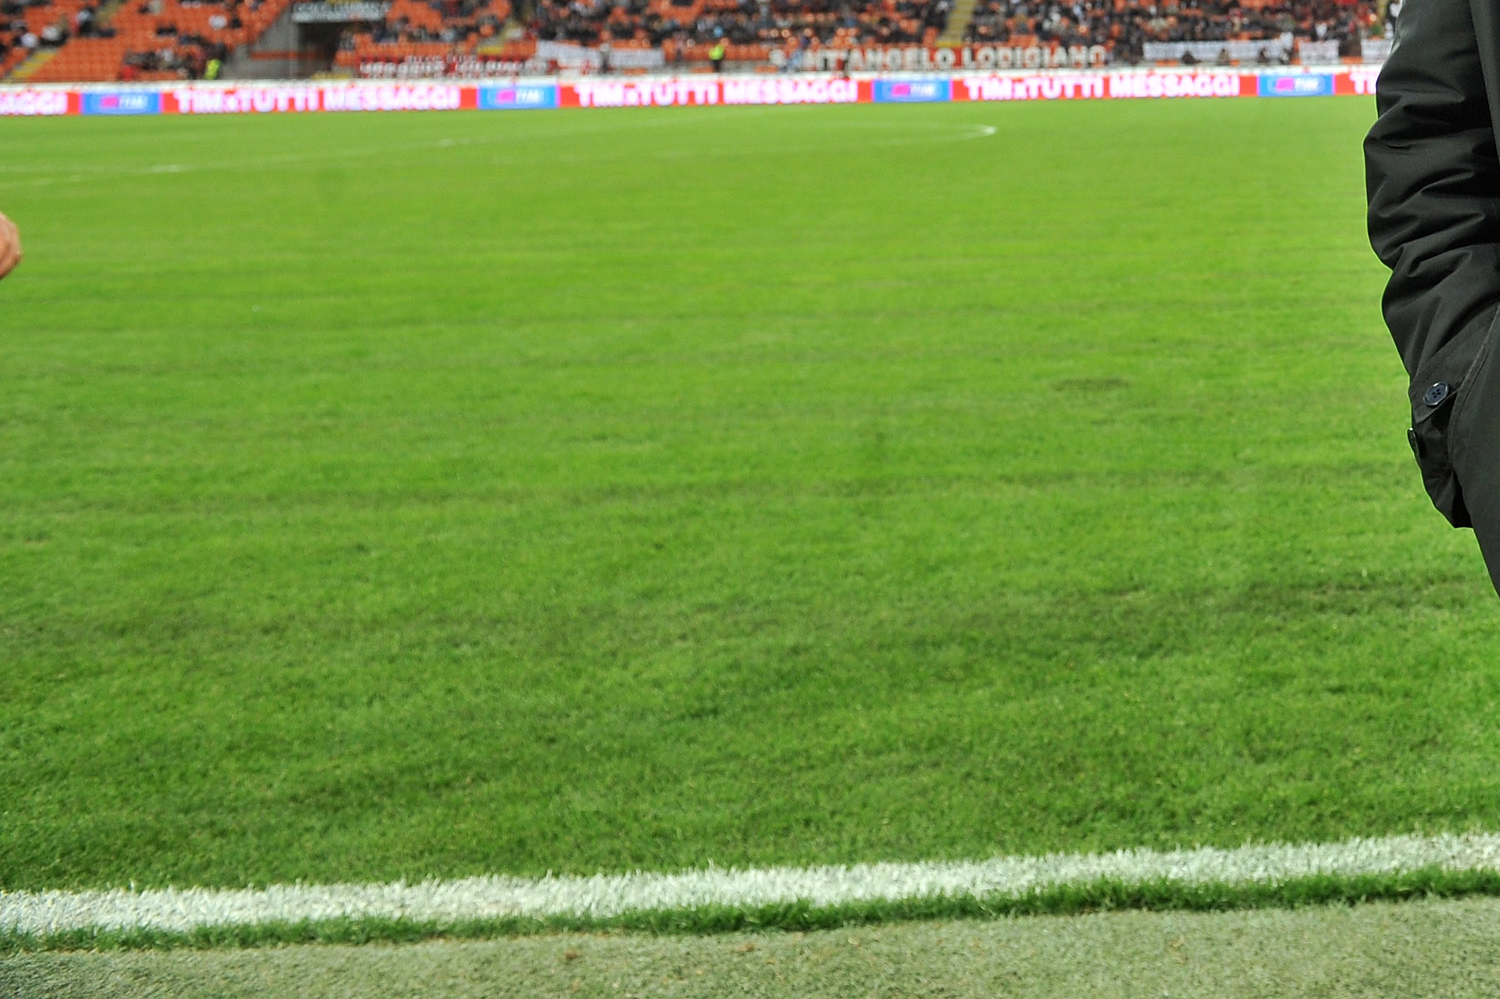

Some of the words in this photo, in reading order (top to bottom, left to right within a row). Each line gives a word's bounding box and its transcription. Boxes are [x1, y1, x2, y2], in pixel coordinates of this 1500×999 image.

[768, 47, 956, 71] SNT'ANGELO
[323, 84, 461, 111] MESSAGGI
[722, 77, 859, 105] MESSAGGI
[1109, 72, 1240, 98] MESSAGGI
[0, 91, 68, 115] AGGI
